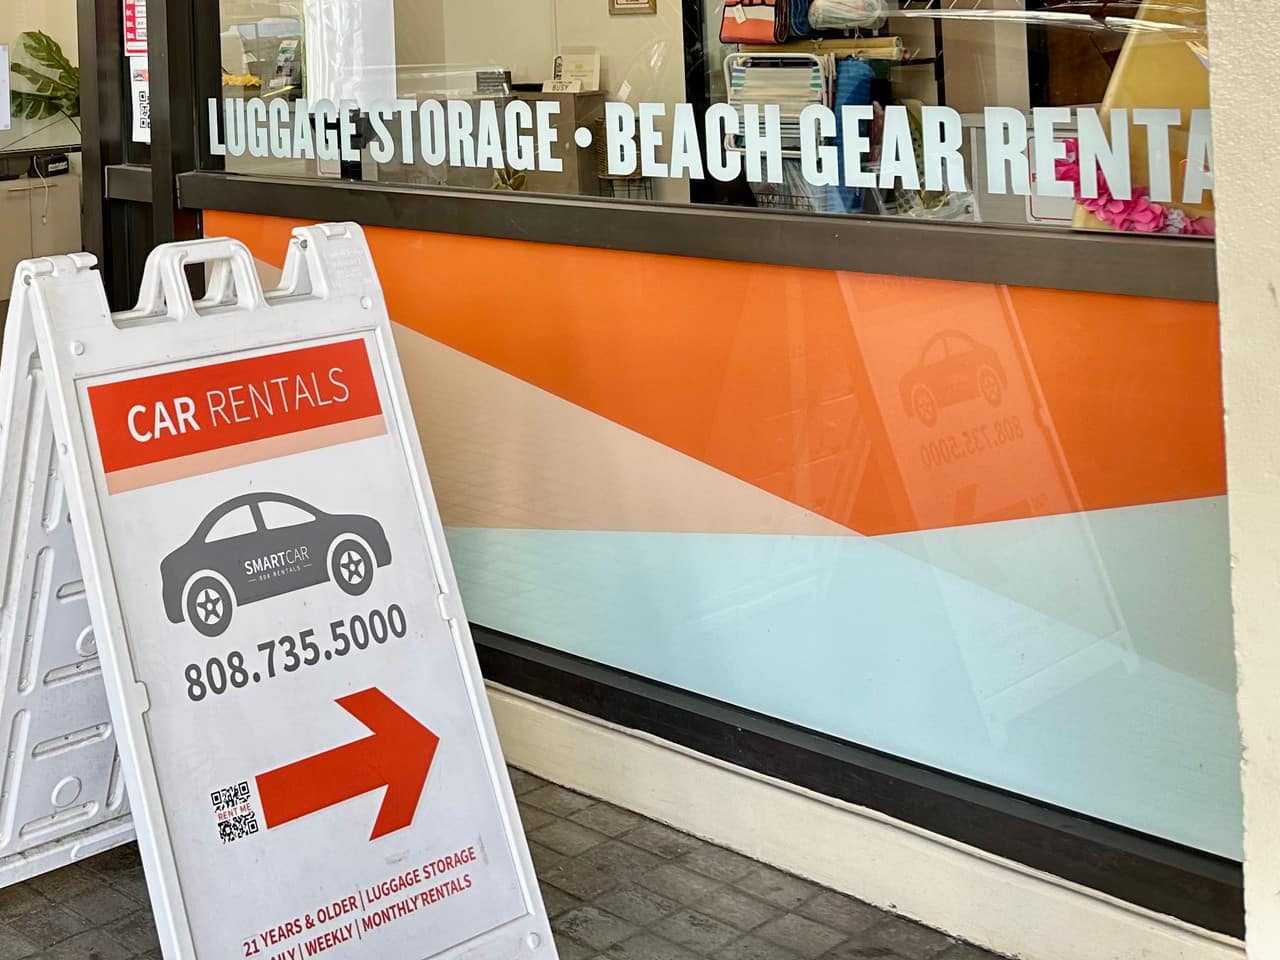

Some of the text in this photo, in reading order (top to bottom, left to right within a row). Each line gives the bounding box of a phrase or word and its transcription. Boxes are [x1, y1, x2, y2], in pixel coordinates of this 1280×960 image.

[207, 97, 361, 162] LUGGAGE
[367, 99, 563, 172] STORAGE
[605, 102, 784, 183] BEACH
[801, 104, 967, 193] GEAR
[127, 367, 350, 442] CAR RENTALS
[244, 546, 310, 575] SMARTCAR
[184, 603, 407, 702] 808.735.5000
[217, 802, 252, 821] RENT ME
[243, 846, 477, 957] 21 YEARS & OLDER LUGGAGE STORAGE
[304, 874, 473, 957] WEEKLY MONTHLY RENTALS
